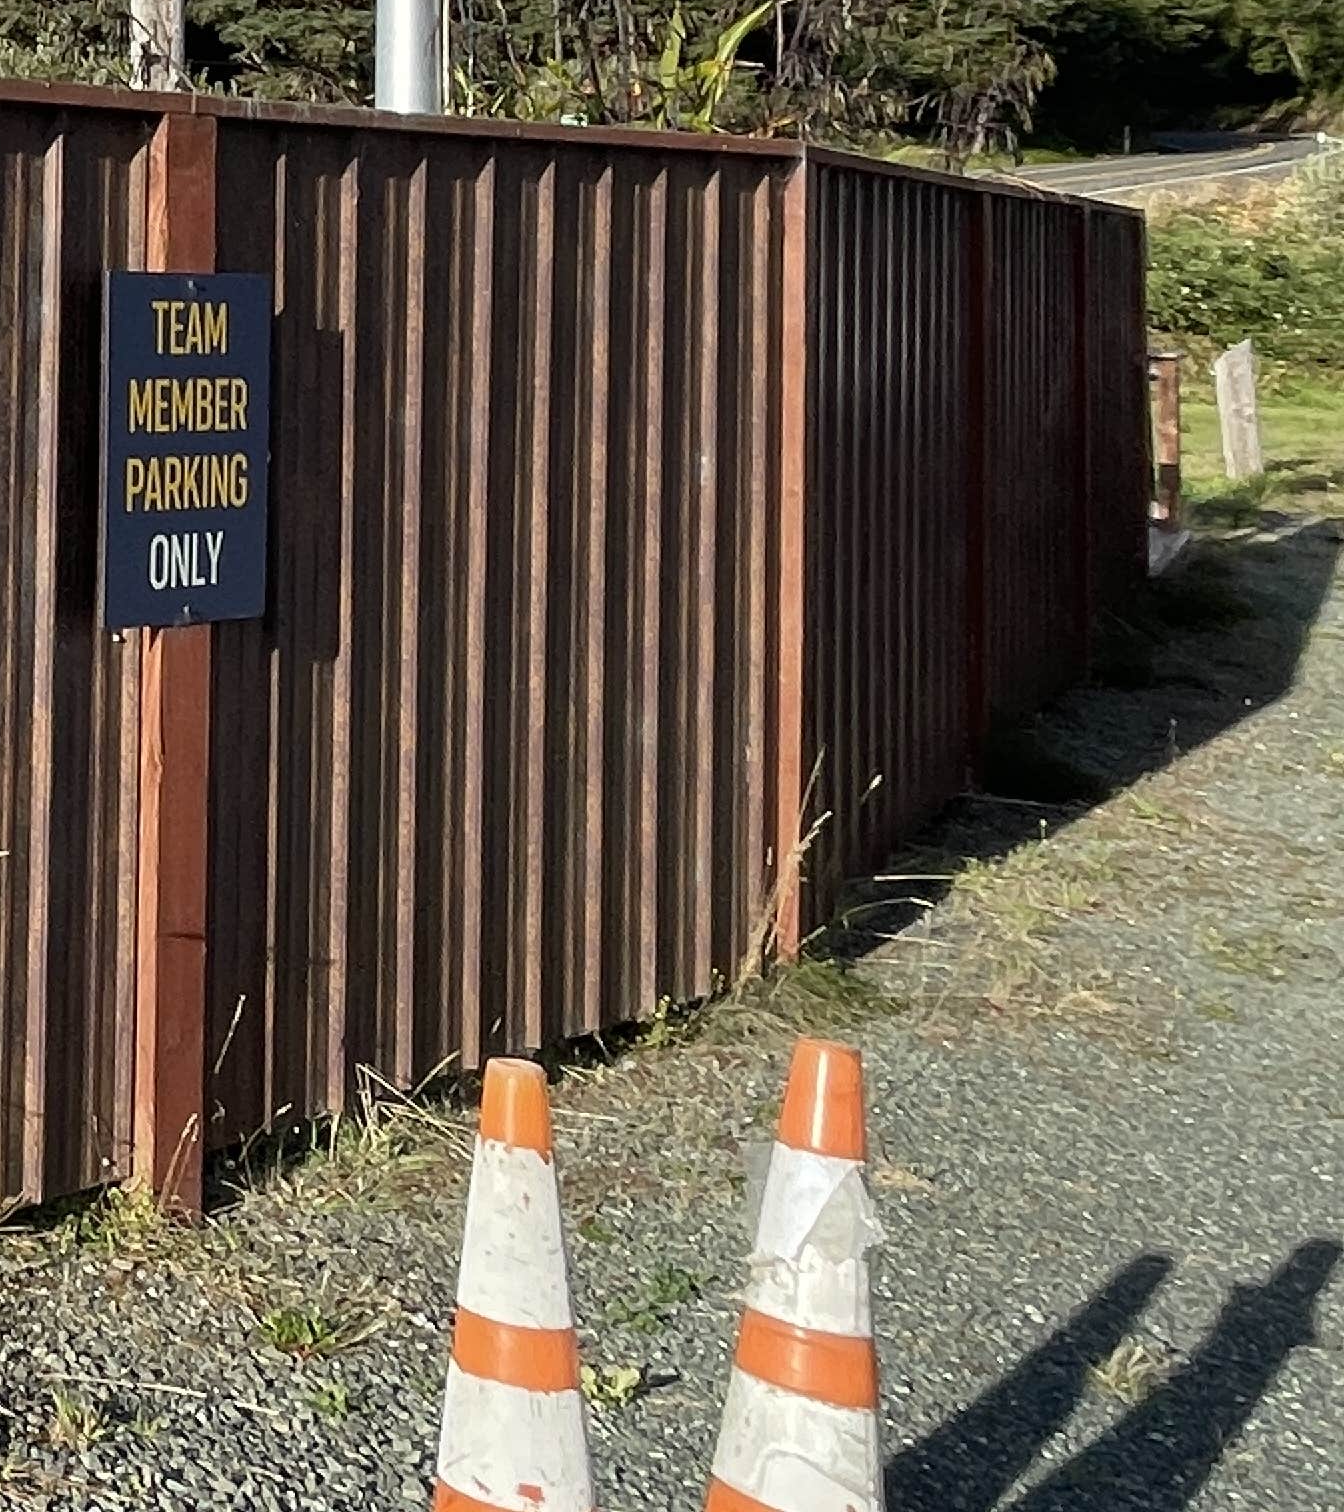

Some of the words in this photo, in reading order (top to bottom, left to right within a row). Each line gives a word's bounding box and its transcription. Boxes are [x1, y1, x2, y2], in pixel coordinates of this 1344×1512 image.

[150, 299, 229, 356] TEAM
[127, 377, 249, 434] MEMBER
[125, 451, 250, 513] PARKING
[149, 530, 225, 590] ONLY
